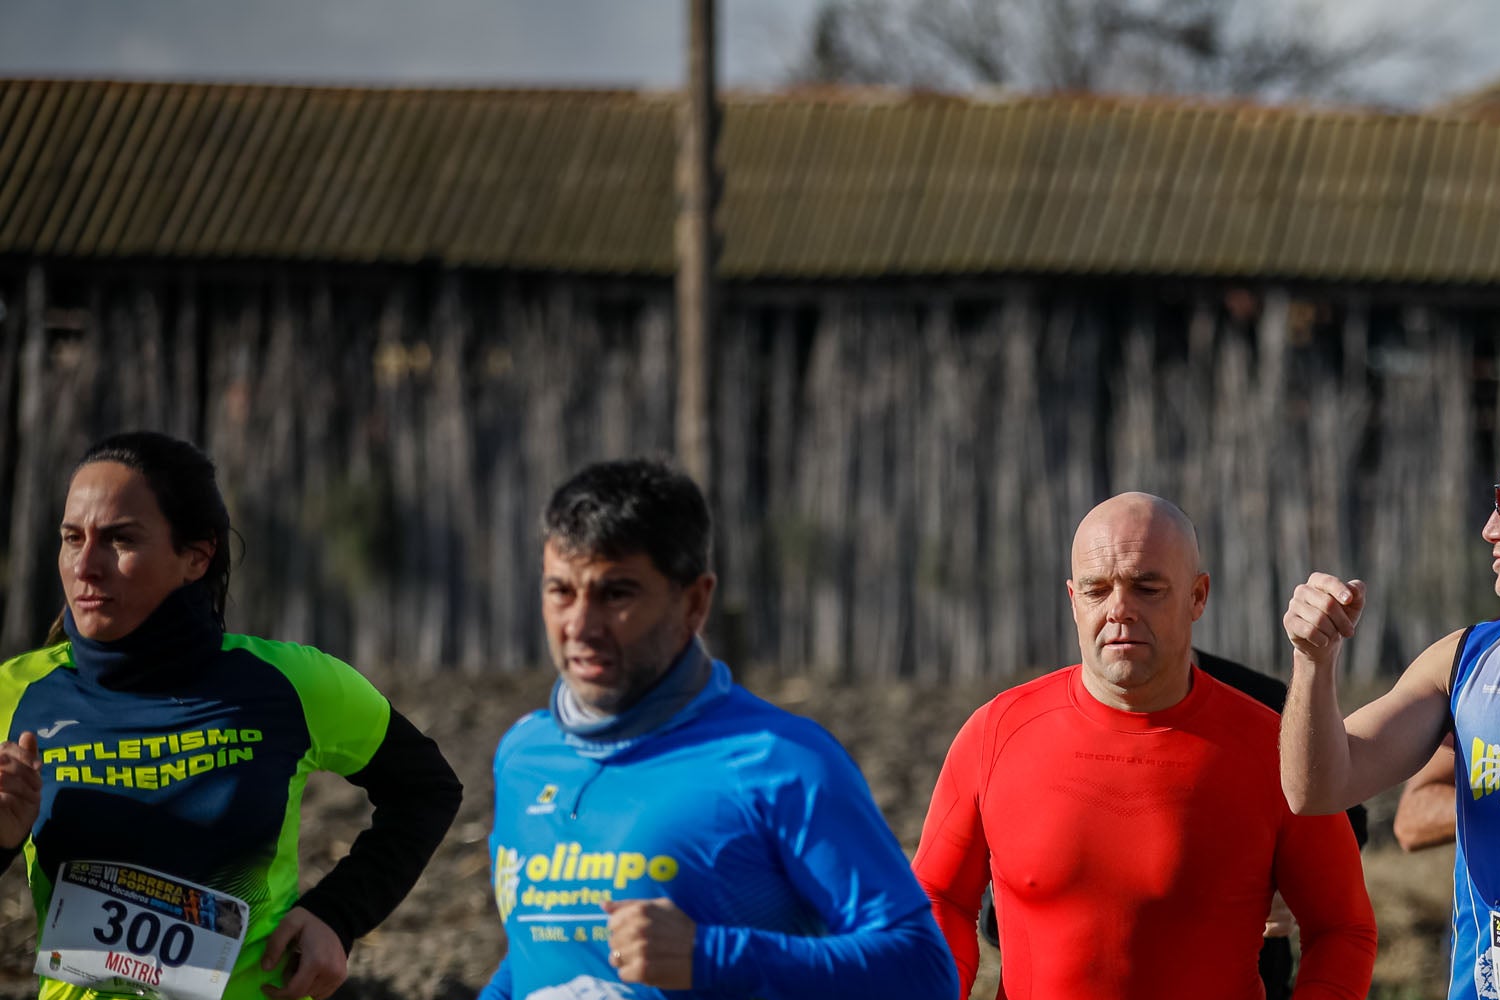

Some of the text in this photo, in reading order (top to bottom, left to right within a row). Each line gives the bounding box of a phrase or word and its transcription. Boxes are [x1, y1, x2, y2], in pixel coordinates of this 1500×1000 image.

[43, 728, 263, 763] ATLETISMO
[55, 748, 253, 790] ALHENDÍN
[104, 866, 120, 883] VII
[118, 867, 183, 897] CARRERA
[525, 842, 679, 889] olimpo
[117, 876, 182, 905] POPULAR
[93, 900, 195, 968] 300
[105, 951, 164, 986] MISTRIS
